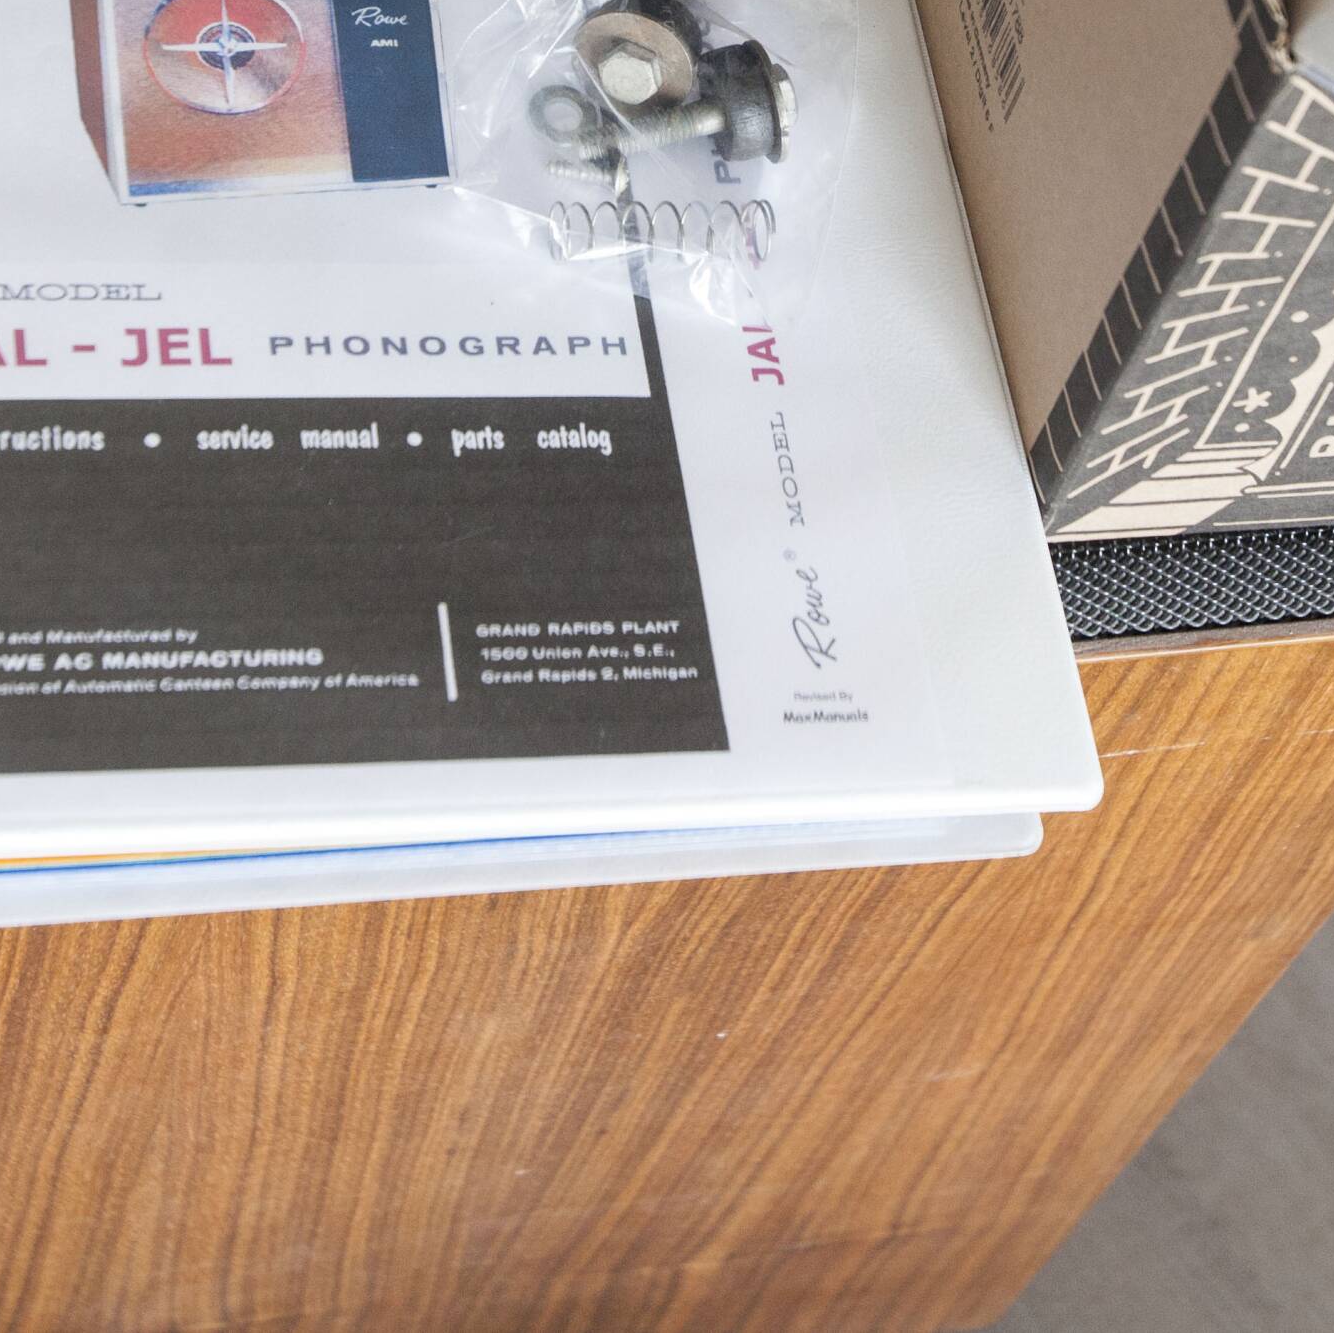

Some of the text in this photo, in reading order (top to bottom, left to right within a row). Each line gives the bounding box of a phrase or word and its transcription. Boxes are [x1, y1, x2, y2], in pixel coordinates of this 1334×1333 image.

[350, 6, 409, 28] Rowe
[369, 38, 399, 48] AMI
[121, 326, 234, 367] JEL
[269, 333, 629, 359] PHONOGRAPH
[196, 426, 274, 453] service
[300, 424, 380, 451] manual
[451, 426, 505, 458] parts
[536, 424, 613, 457] catalog
[770, 411, 805, 527] MODEL
[791, 565, 838, 670] Rowe
[6, 629, 43, 646] and
[45, 628, 172, 646] Manufactured
[175, 628, 199, 647] by
[475, 619, 681, 639] GRAND RAPIDS PLANT
[101, 647, 325, 670] MANUFACTURING
[531, 645, 583, 661] Union
[63, 677, 158, 695] Automatic
[236, 674, 321, 694] Company
[323, 672, 344, 689] of
[345, 671, 421, 689] America
[480, 669, 534, 685] Grand
[538, 667, 599, 684] Rapids
[623, 665, 699, 682] Michigan
